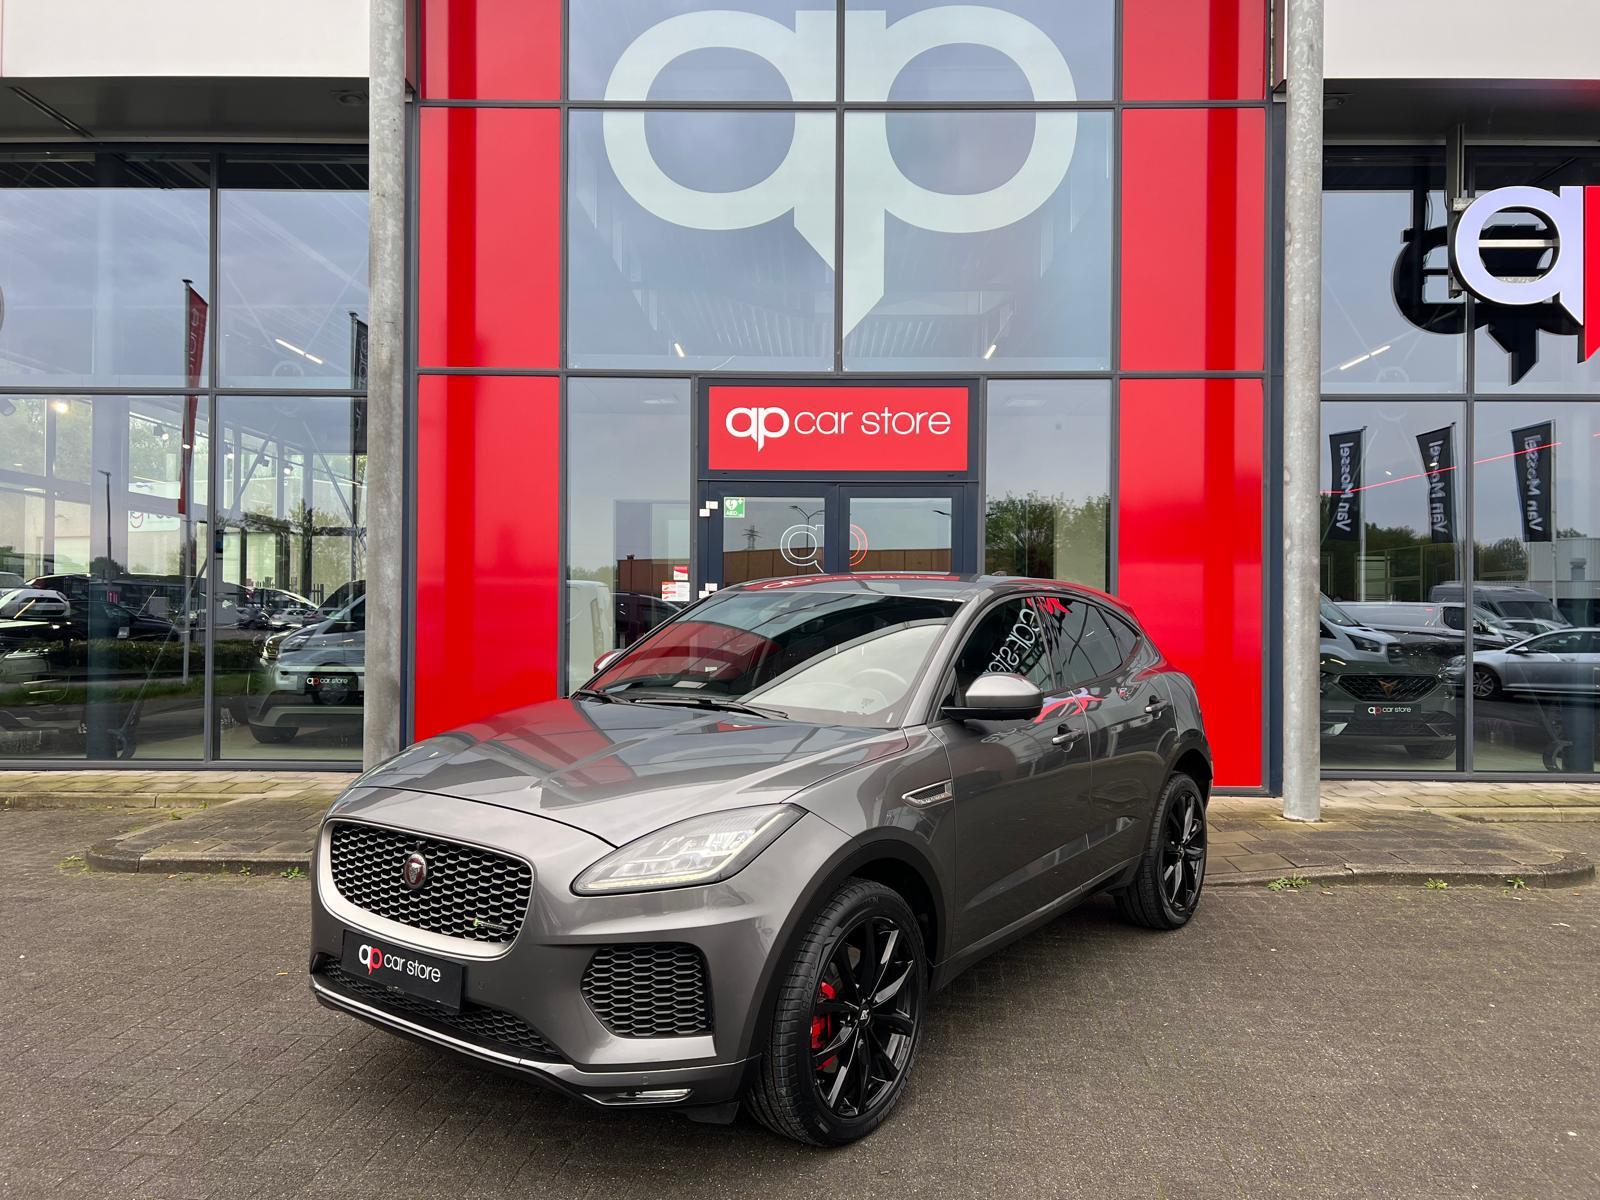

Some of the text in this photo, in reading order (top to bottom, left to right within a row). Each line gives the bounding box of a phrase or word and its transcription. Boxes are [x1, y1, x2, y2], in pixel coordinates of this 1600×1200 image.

[1454, 185, 1600, 363] a
[725, 406, 951, 452] ap car store
[358, 944, 441, 983] ap car store
